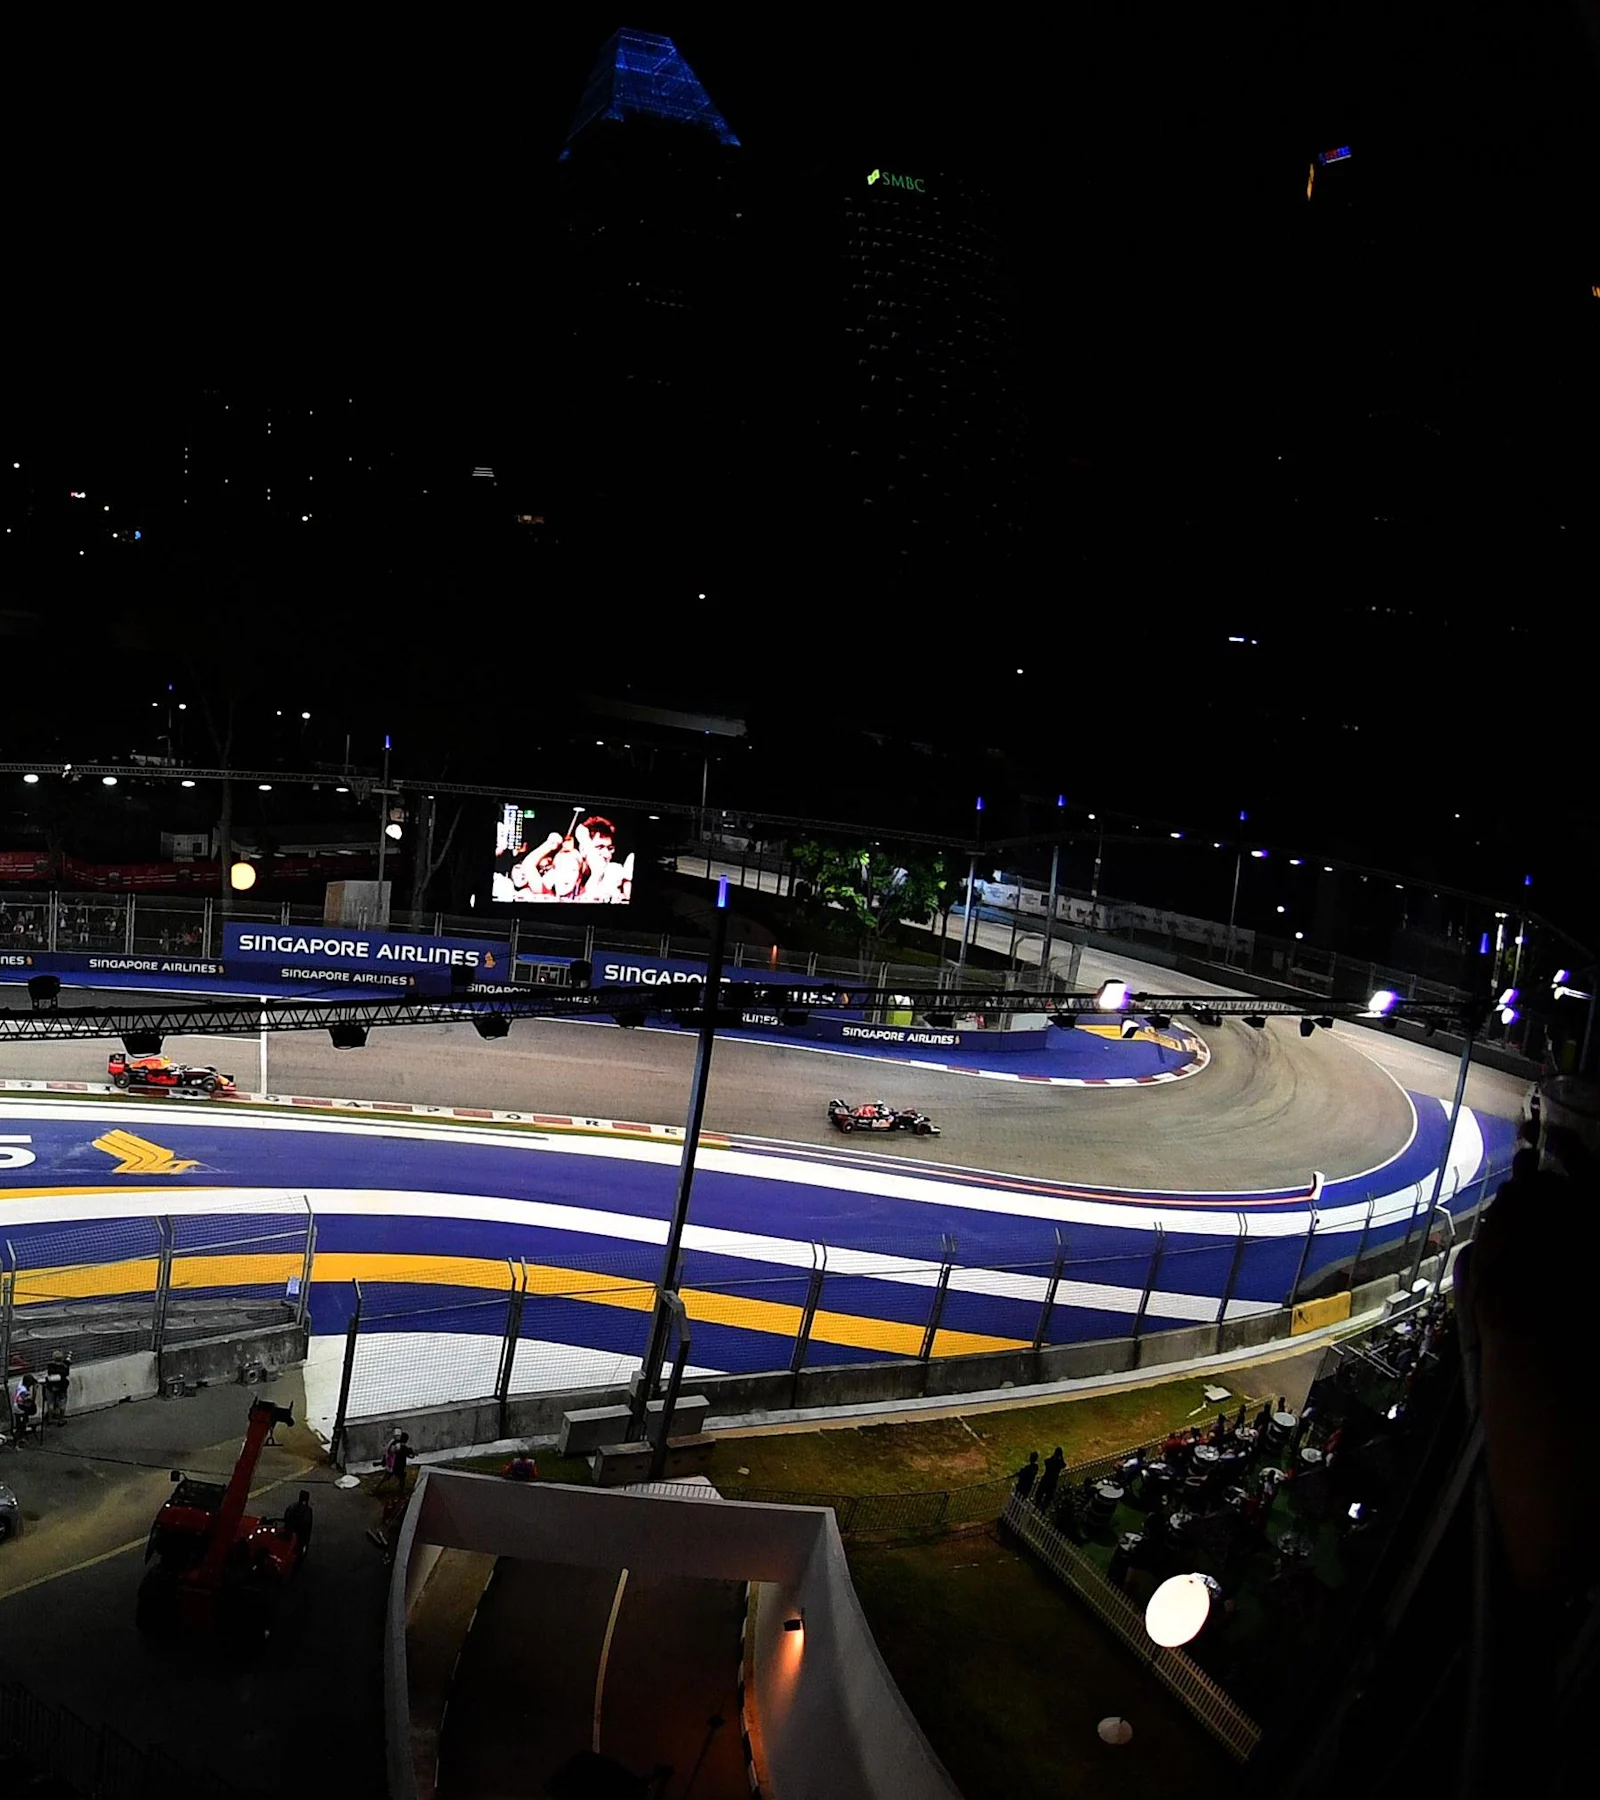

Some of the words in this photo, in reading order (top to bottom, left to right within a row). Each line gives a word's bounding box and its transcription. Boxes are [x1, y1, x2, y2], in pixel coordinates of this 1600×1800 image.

[882, 171, 926, 193] SMBC
[239, 934, 370, 958] SINGAPORE
[376, 943, 480, 967] AIRLINES
[89, 958, 159, 971] SINGAPORE
[161, 962, 217, 974] AIRLINES
[603, 964, 731, 986] SINGAPO
[281, 968, 350, 982] SINGAPORE
[352, 973, 408, 986] AIRLINES
[841, 1026, 905, 1042] SINGAPORE
[906, 1033, 955, 1045] AIRLINES
